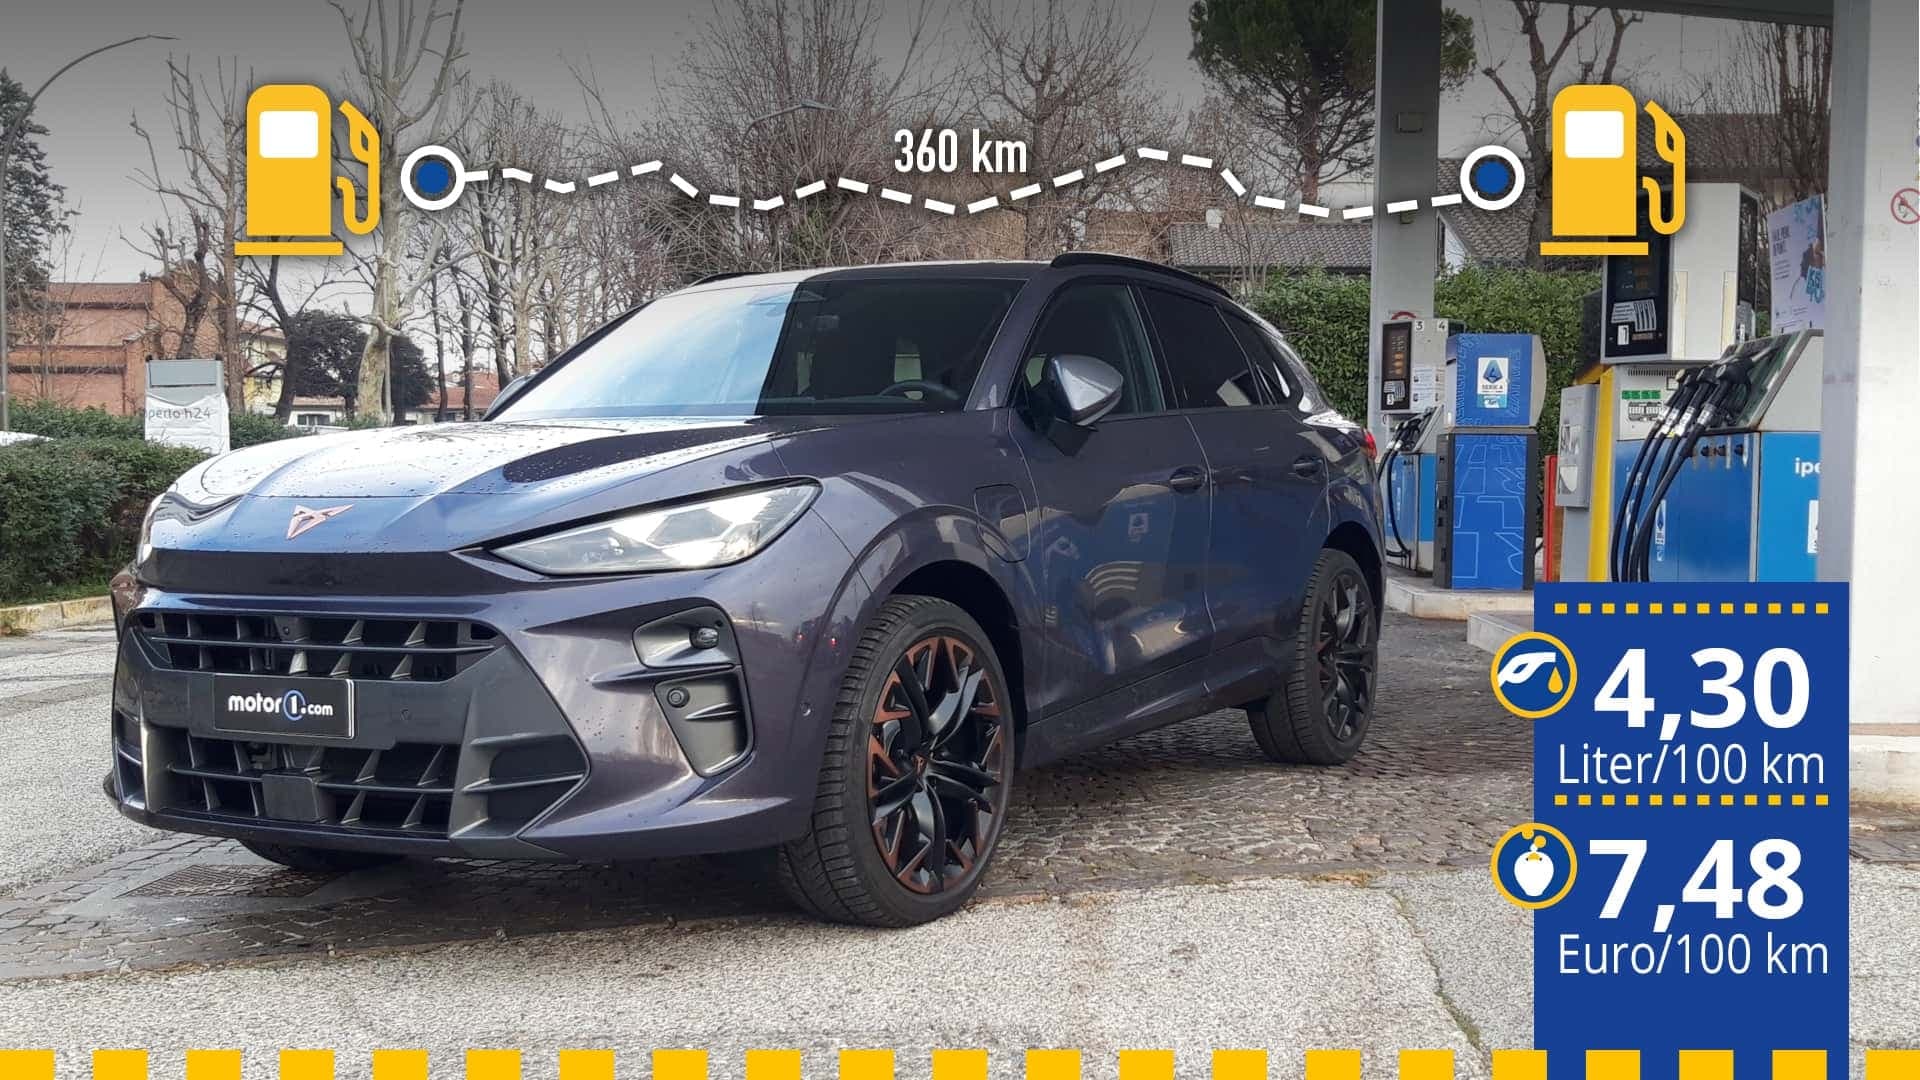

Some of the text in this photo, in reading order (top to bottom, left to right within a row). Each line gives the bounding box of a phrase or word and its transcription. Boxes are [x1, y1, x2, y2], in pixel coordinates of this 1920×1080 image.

[144, 407, 211, 421] perto h24
[228, 690, 333, 720] motor1.com
